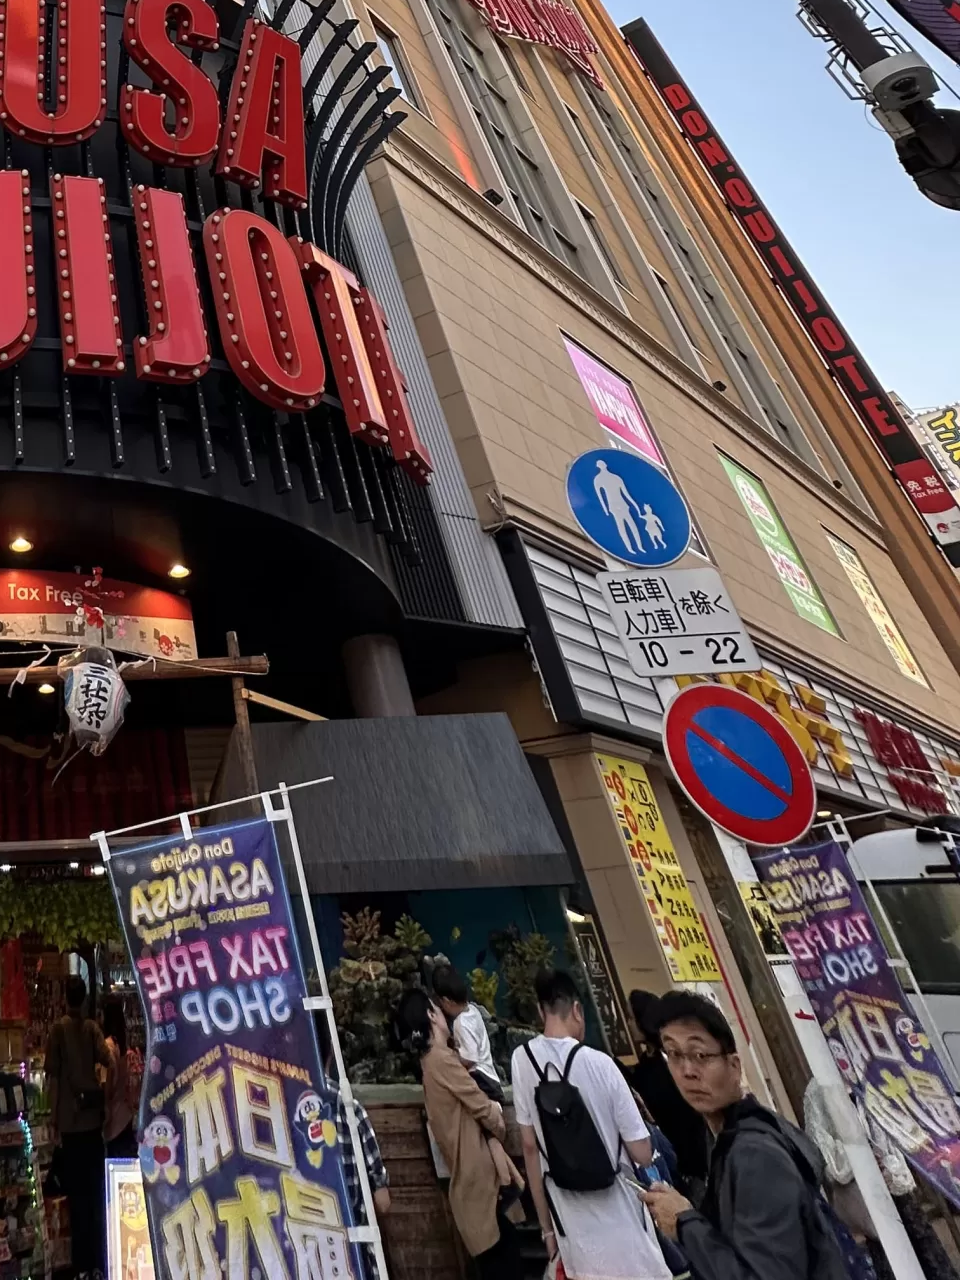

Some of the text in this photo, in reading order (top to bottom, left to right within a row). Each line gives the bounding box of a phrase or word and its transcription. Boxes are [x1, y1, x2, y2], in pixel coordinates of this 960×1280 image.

[663, 83, 899, 436] DON.QUIJOTE
[905, 475, 941, 493] 免税
[912, 487, 945, 499] Tax Free
[7, 583, 84, 603] Tax Free
[607, 577, 666, 604] 自転車
[679, 589, 730, 616] を除く
[625, 607, 679, 636] 人力車
[639, 640, 669, 668] 10
[705, 637, 746, 664] 22
